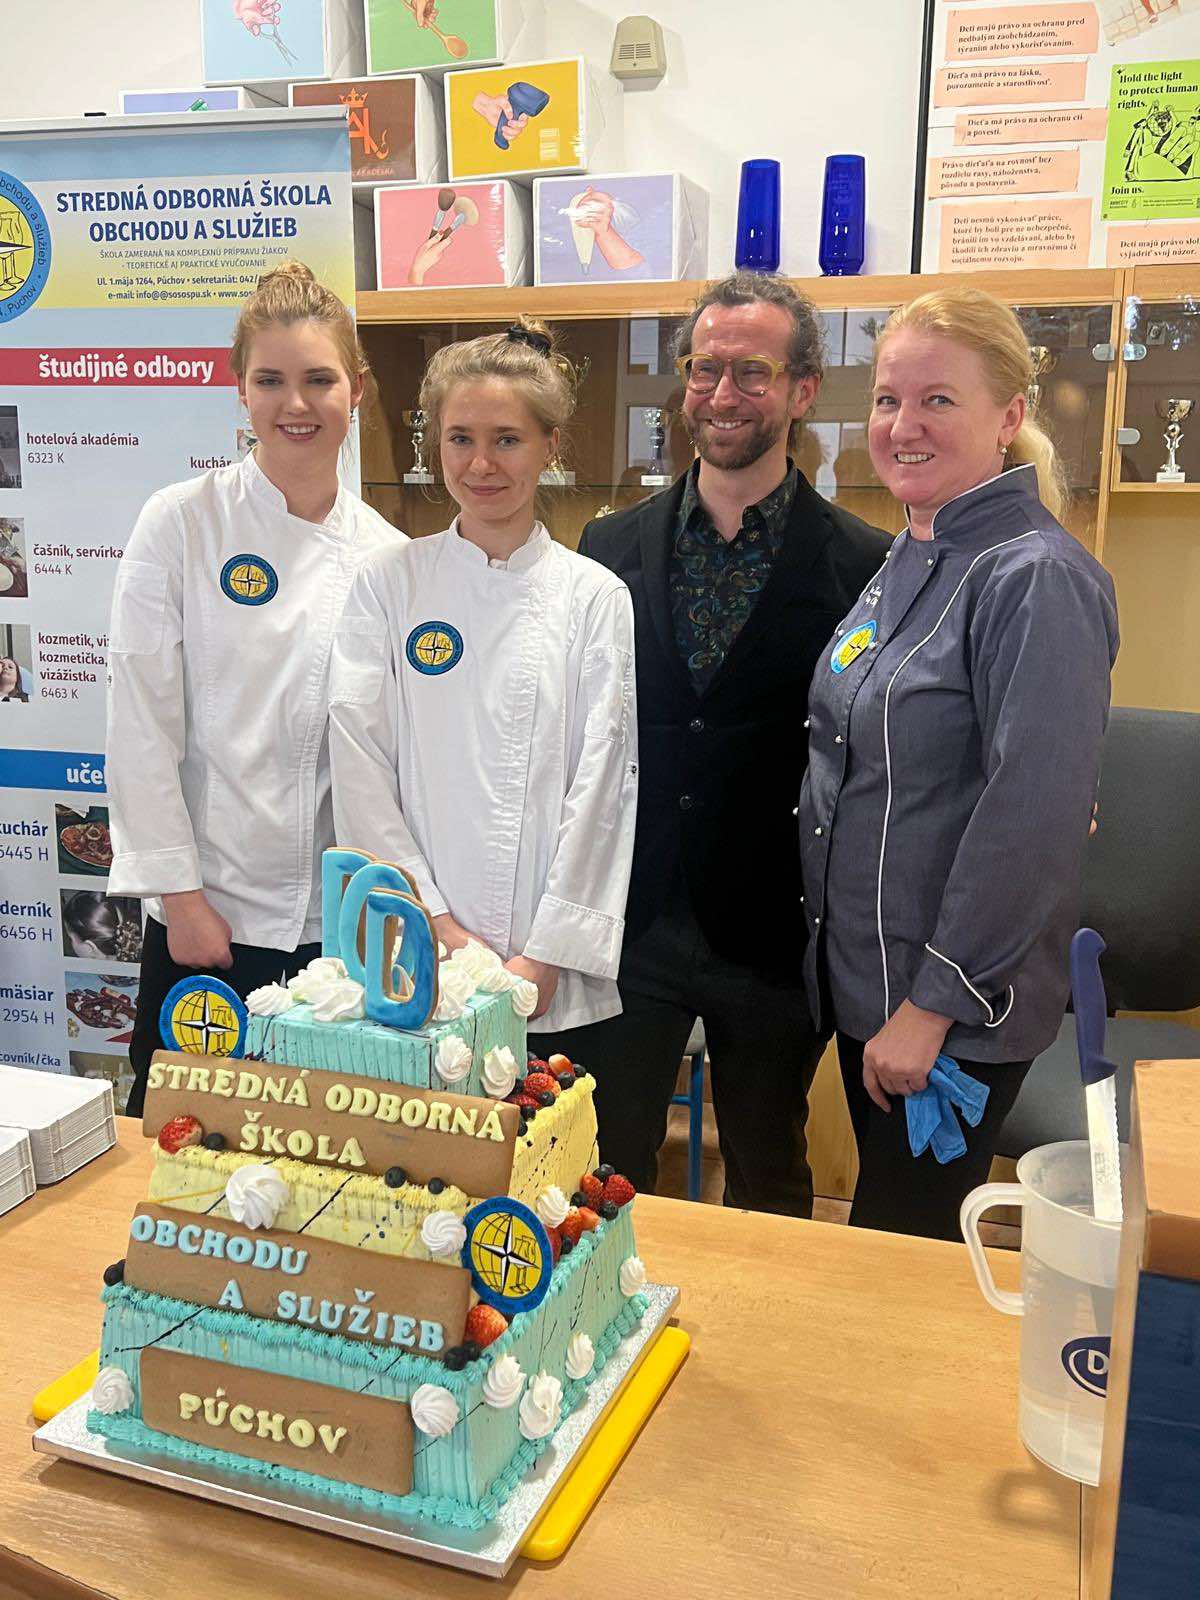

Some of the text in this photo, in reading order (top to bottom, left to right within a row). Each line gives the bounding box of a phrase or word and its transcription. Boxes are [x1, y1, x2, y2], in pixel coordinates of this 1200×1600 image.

[959, 25, 975, 33] Deti
[977, 23, 996, 32] majú
[998, 21, 1020, 31] právo
[1033, 20, 1065, 28] ochranu
[1066, 18, 1085, 27] pred
[958, 34, 995, 44] nedbalým
[958, 45, 987, 54] týraním
[989, 43, 1010, 51] alebo
[947, 71, 969, 80] Dieťa
[984, 71, 1006, 80] právo
[1019, 69, 1042, 77] lásku,
[1119, 71, 1183, 83] Hold the light
[946, 81, 994, 91] porozumenie
[1130, 86, 1164, 97] protect
[1166, 84, 1198, 93] human
[1117, 99, 1148, 110] rights.
[967, 118, 988, 126] Dieťa
[990, 117, 1003, 125] má
[1004, 117, 1026, 126] právo
[1039, 114, 1071, 122] ochranu
[942, 161, 964, 169] Právo
[965, 159, 994, 168] dieťaťa
[1007, 156, 1038, 165] rovnosť
[1039, 156, 1052, 164] bez
[941, 170, 971, 179] rozdielu
[973, 171, 991, 179] rasy,
[940, 180, 968, 190] pôvodu
[976, 179, 1017, 189] postavenia.
[1111, 186, 1144, 195] Join us.
[57, 179, 332, 213] STREDNÁ ODBORNÁ ŠKOLA
[89, 211, 297, 242] OBCHODU A SLUŽIEB
[954, 217, 969, 225] Deti
[974, 226, 983, 234] by
[1066, 233, 1075, 241] by
[1138, 239, 1159, 249] majú
[1160, 238, 1184, 248] právo
[100, 249, 123, 259] ŠKOLA
[124, 248, 164, 258] ZAMERANÁ
[177, 247, 221, 257] KOMPLEXNÚ
[223, 246, 260, 256] PRÍPRAVU
[261, 245, 288, 255] ŽIAKOV
[1120, 250, 1152, 259] vyjadriť
[1172, 248, 1197, 256] názor.
[127, 261, 169, 270] TEORETICKÉ
[171, 261, 178, 269] AJ
[180, 259, 218, 269] PRAKTICKÉ
[136, 277, 155, 286] 1264,
[157, 276, 186, 285] Púchov
[191, 274, 238, 285] sekretariát:
[108, 290, 134, 299] e-mail:
[136, 290, 212, 301] info@@sosospu.sk
[39, 353, 215, 384] študijné odbory
[26, 432, 139, 446] hotelová akadémia
[27, 452, 65, 464] 6323 K
[33, 543, 124, 560] čašník, servírka
[34, 563, 73, 575] 6444 K
[38, 632, 110, 648] kozmetik, vi
[39, 651, 108, 668] kozmetička,
[40, 668, 97, 683] vizážistka
[41, 687, 79, 700] 6463 K
[38, 847, 49, 861] H
[0, 900, 52, 918] derník
[0, 924, 52, 942] 6456 H
[0, 984, 54, 1002] mäsiar
[3, 1008, 55, 1025] 2954 H
[147, 1062, 506, 1143] STREDNÁ ODBORNÁ
[239, 1109, 367, 1167] ŠKOLA
[130, 1214, 309, 1275] OBCHODU
[217, 1279, 446, 1353] A SLUŽIEB
[178, 1388, 348, 1455] PÚCHOV
